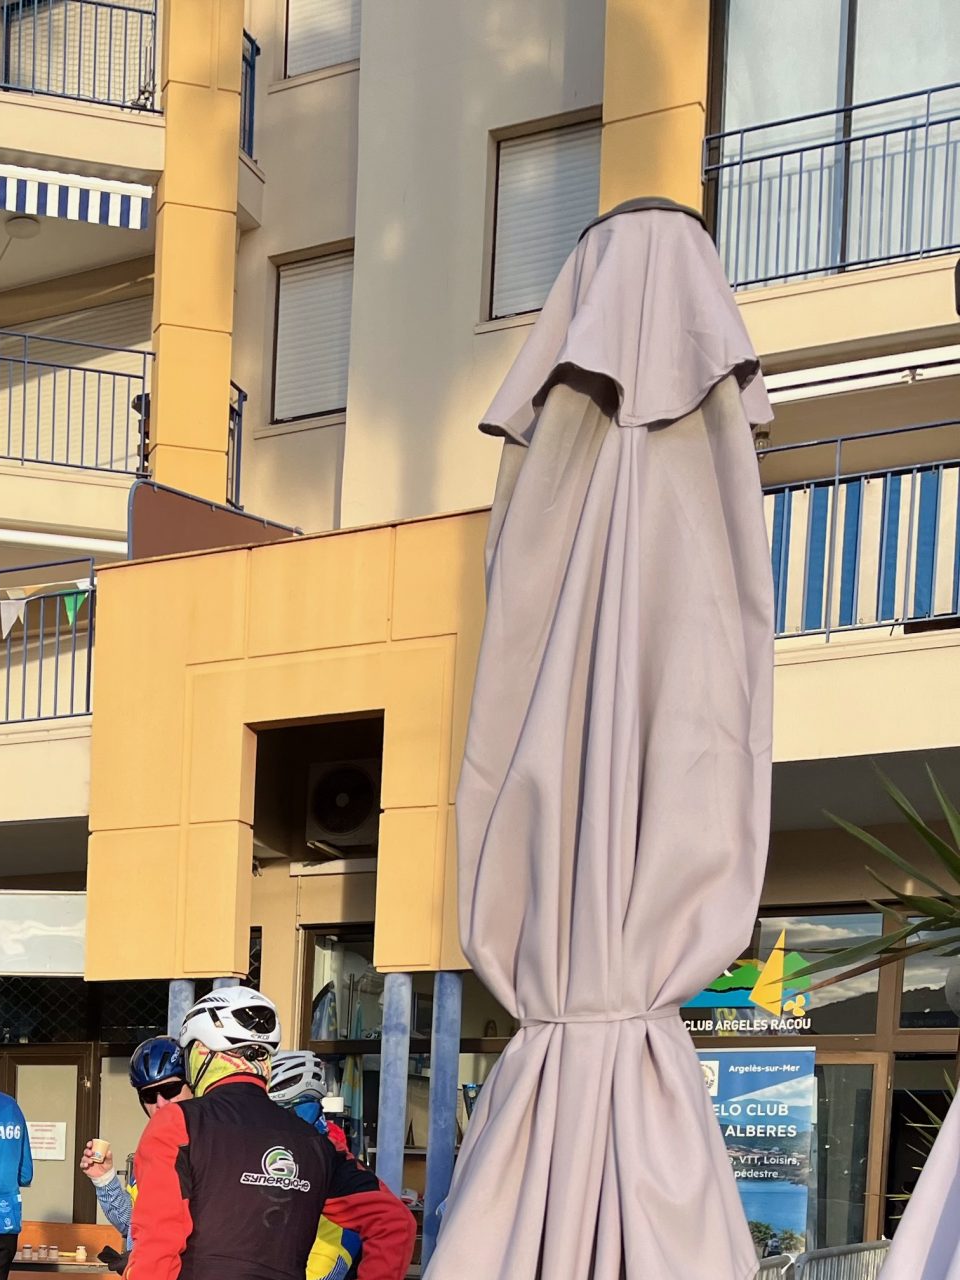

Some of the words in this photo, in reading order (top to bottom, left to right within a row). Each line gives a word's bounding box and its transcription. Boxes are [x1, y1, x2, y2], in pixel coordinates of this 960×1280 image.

[685, 1020, 713, 1031] CLUB
[715, 1019, 768, 1031] ARGELES
[770, 1018, 811, 1031] RACOU
[728, 1064, 800, 1074] Argelès-sur-Mer
[714, 1104, 741, 1116] ELO
[746, 1104, 789, 1116] CLUB
[725, 1125, 797, 1137] ALBERES
[740, 1156, 761, 1165] VTT,
[764, 1156, 800, 1166] Loisirs,
[734, 1169, 779, 1178] pédestre
